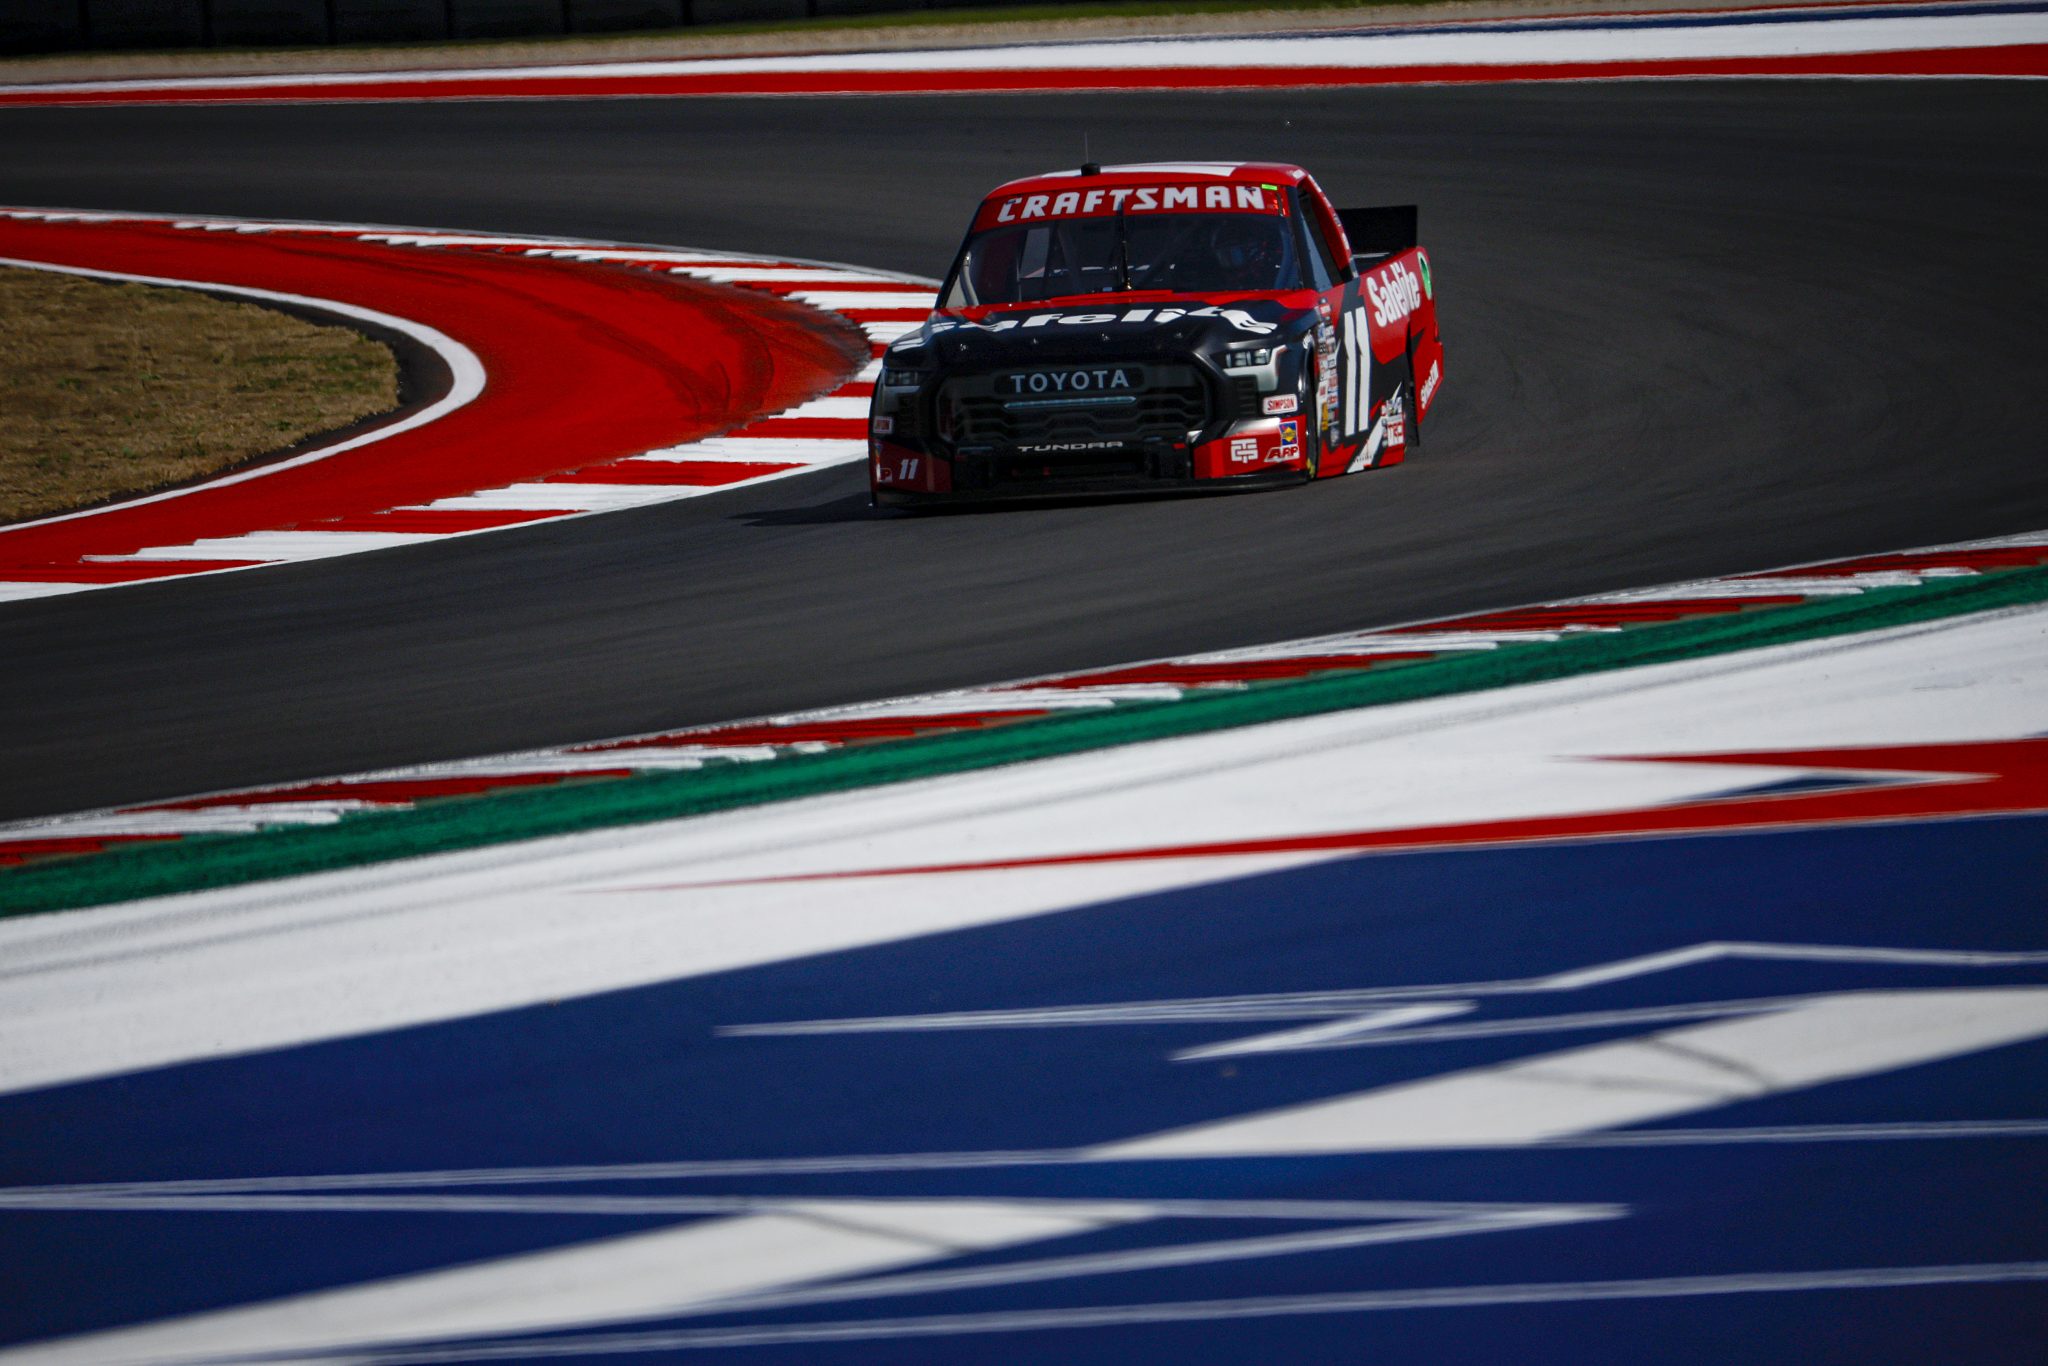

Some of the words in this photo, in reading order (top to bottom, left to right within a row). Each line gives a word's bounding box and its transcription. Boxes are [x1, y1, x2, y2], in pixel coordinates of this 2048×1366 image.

[997, 185, 1265, 223] CRAFTSMAN
[1366, 260, 1421, 328] Safelite
[1010, 369, 1129, 393] TOYOTA
[1344, 306, 1371, 438] 11
[1267, 399, 1295, 411] SIMPSON
[1017, 441, 1123, 452] TUNDRA
[1264, 446, 1299, 462] ARP
[899, 458, 919, 480] 11
